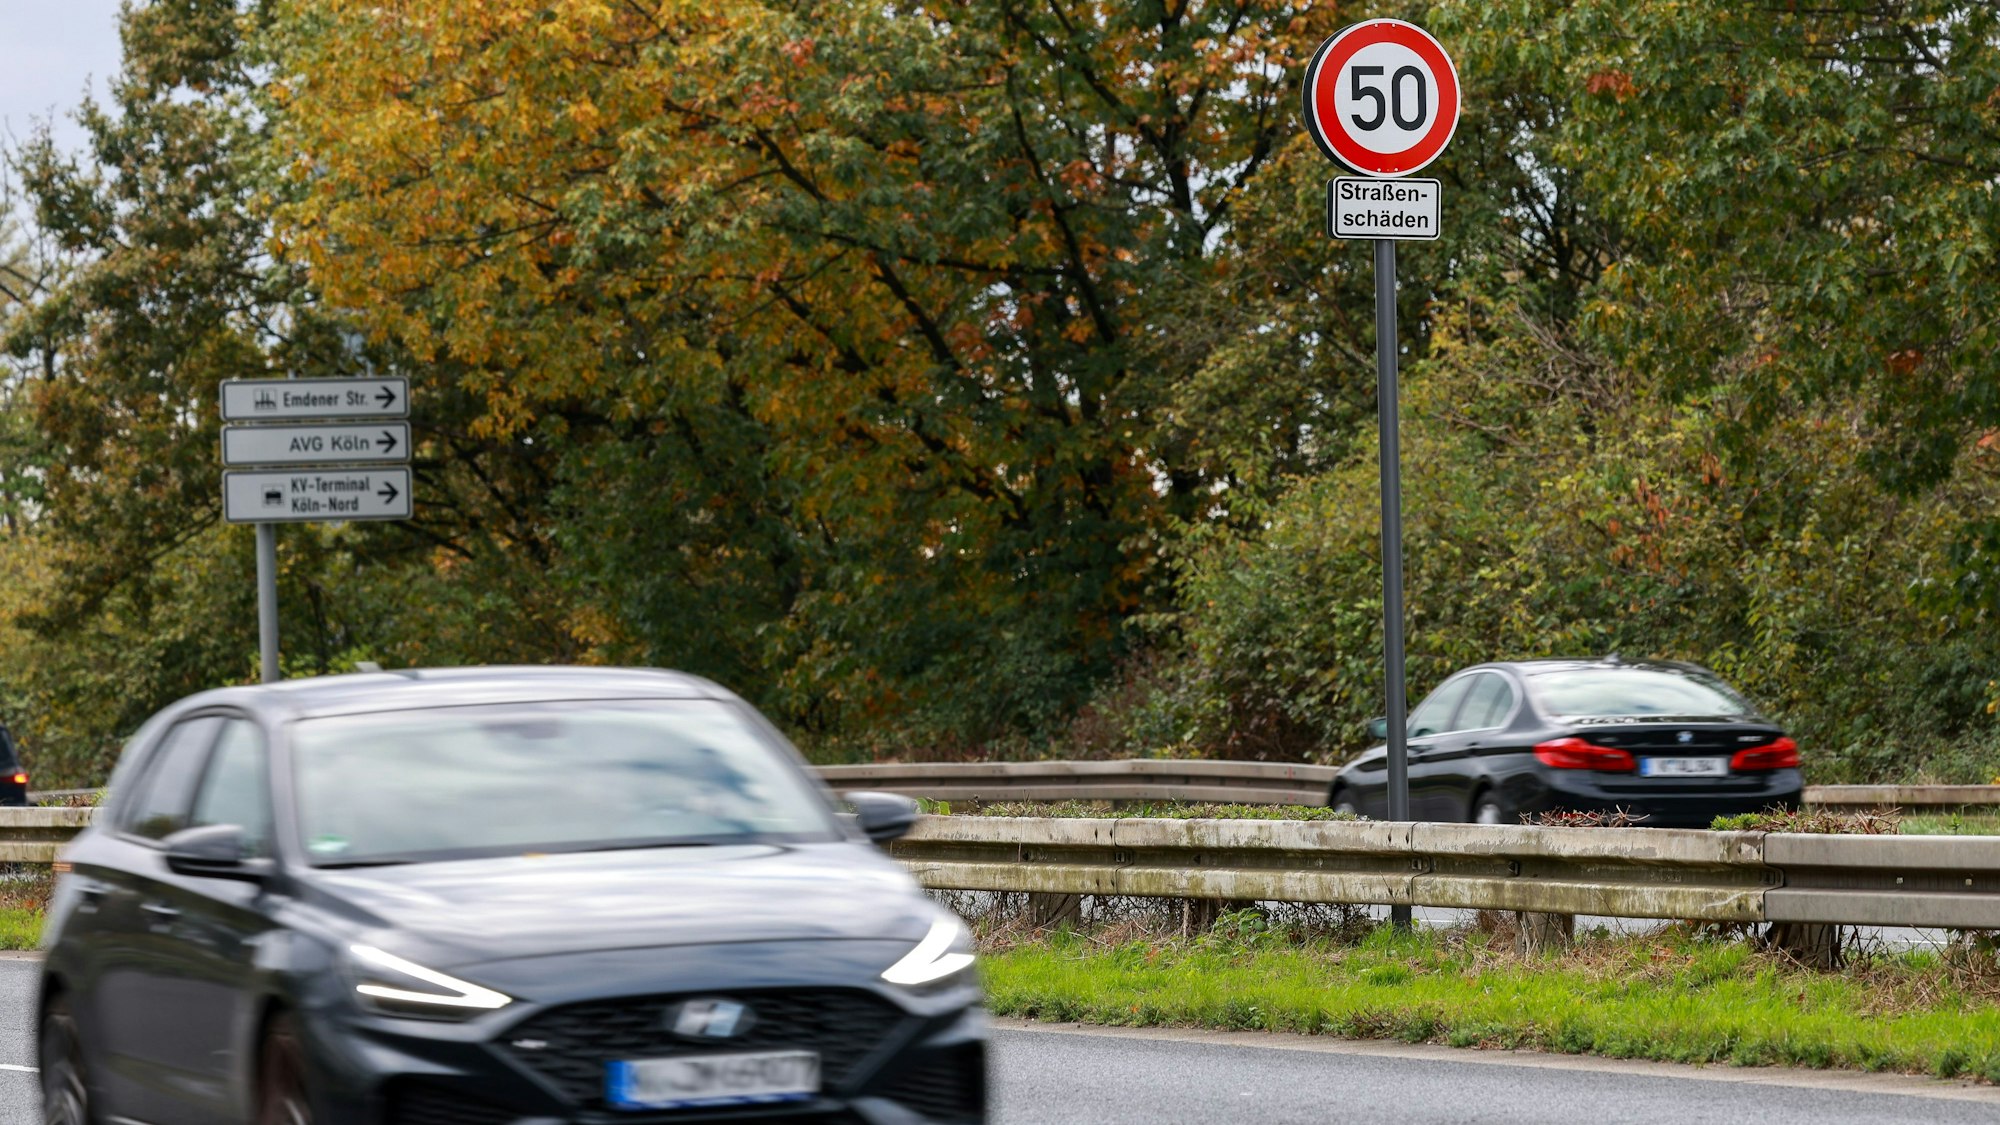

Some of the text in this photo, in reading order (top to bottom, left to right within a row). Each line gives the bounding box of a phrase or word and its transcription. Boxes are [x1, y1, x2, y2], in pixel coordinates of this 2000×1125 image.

[1351, 65, 1427, 131] 50
[1341, 183, 1428, 202] Straßen-
[1343, 210, 1429, 228] schäden
[283, 390, 368, 407] Emdener Str.
[289, 434, 370, 452] AVG Köln
[291, 476, 370, 493] KV-Terminal
[291, 497, 359, 513] Köln-Nord
